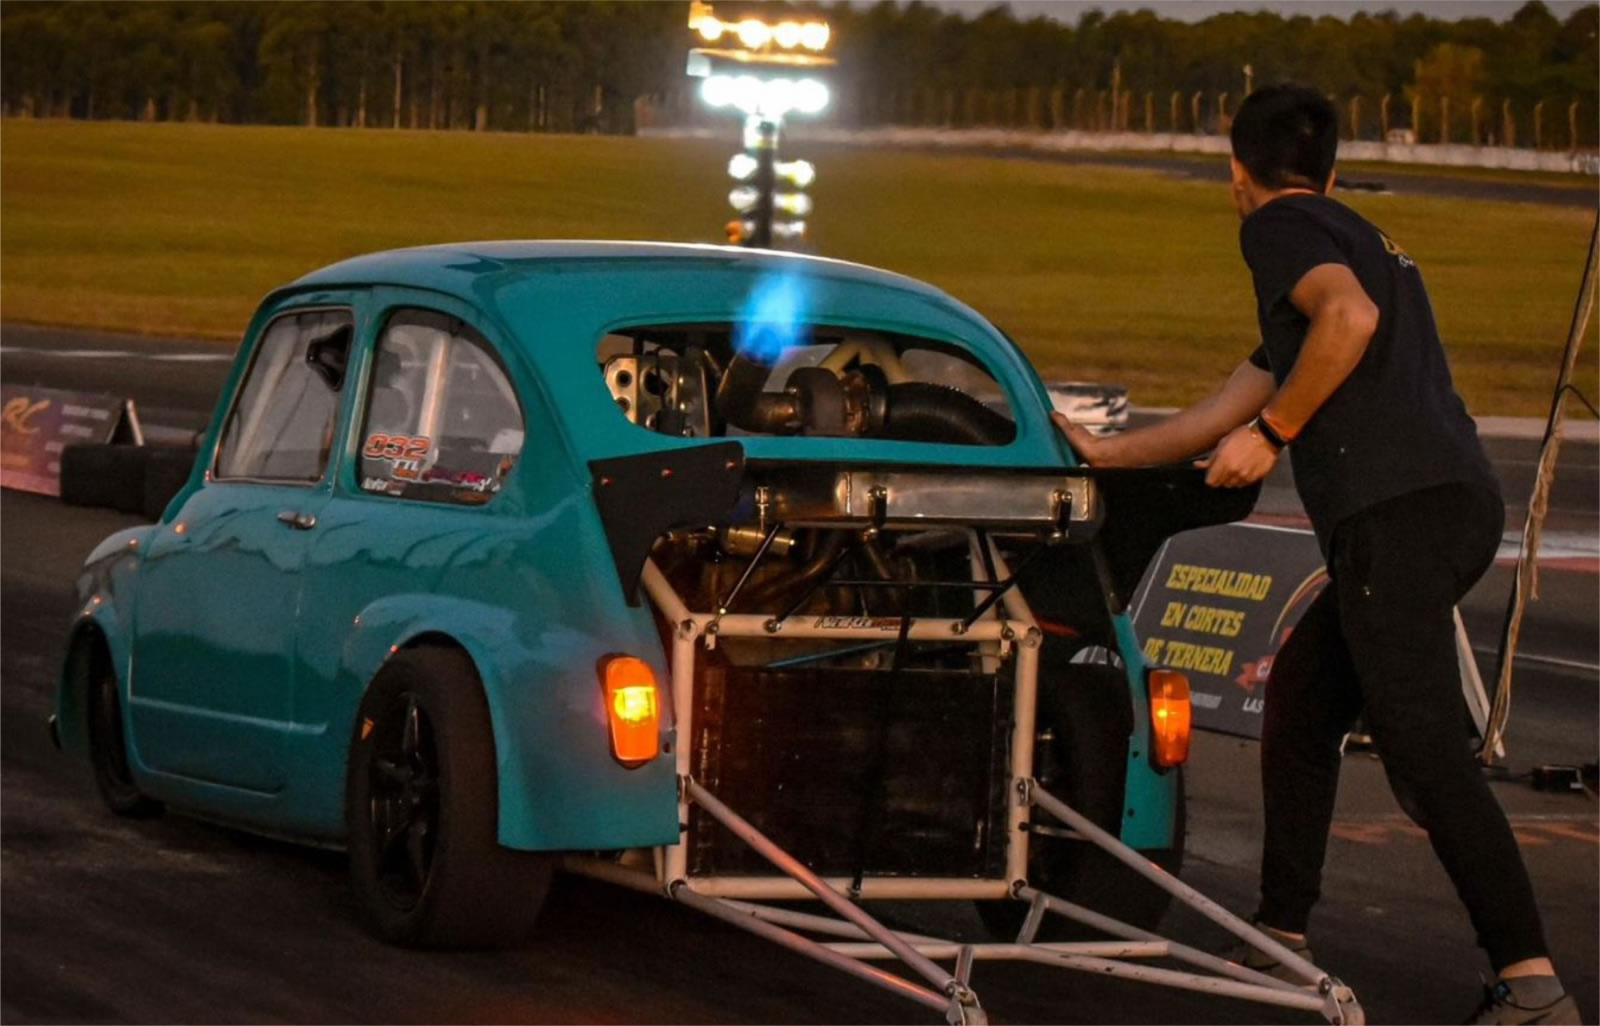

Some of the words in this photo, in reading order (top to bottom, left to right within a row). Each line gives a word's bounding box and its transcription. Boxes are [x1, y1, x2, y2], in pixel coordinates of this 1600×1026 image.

[1166, 565, 1272, 600] ESPECIALIDAD
[1161, 603, 1187, 628] EN
[1184, 606, 1245, 637] CORTES
[1164, 642, 1234, 676] TERNERA
